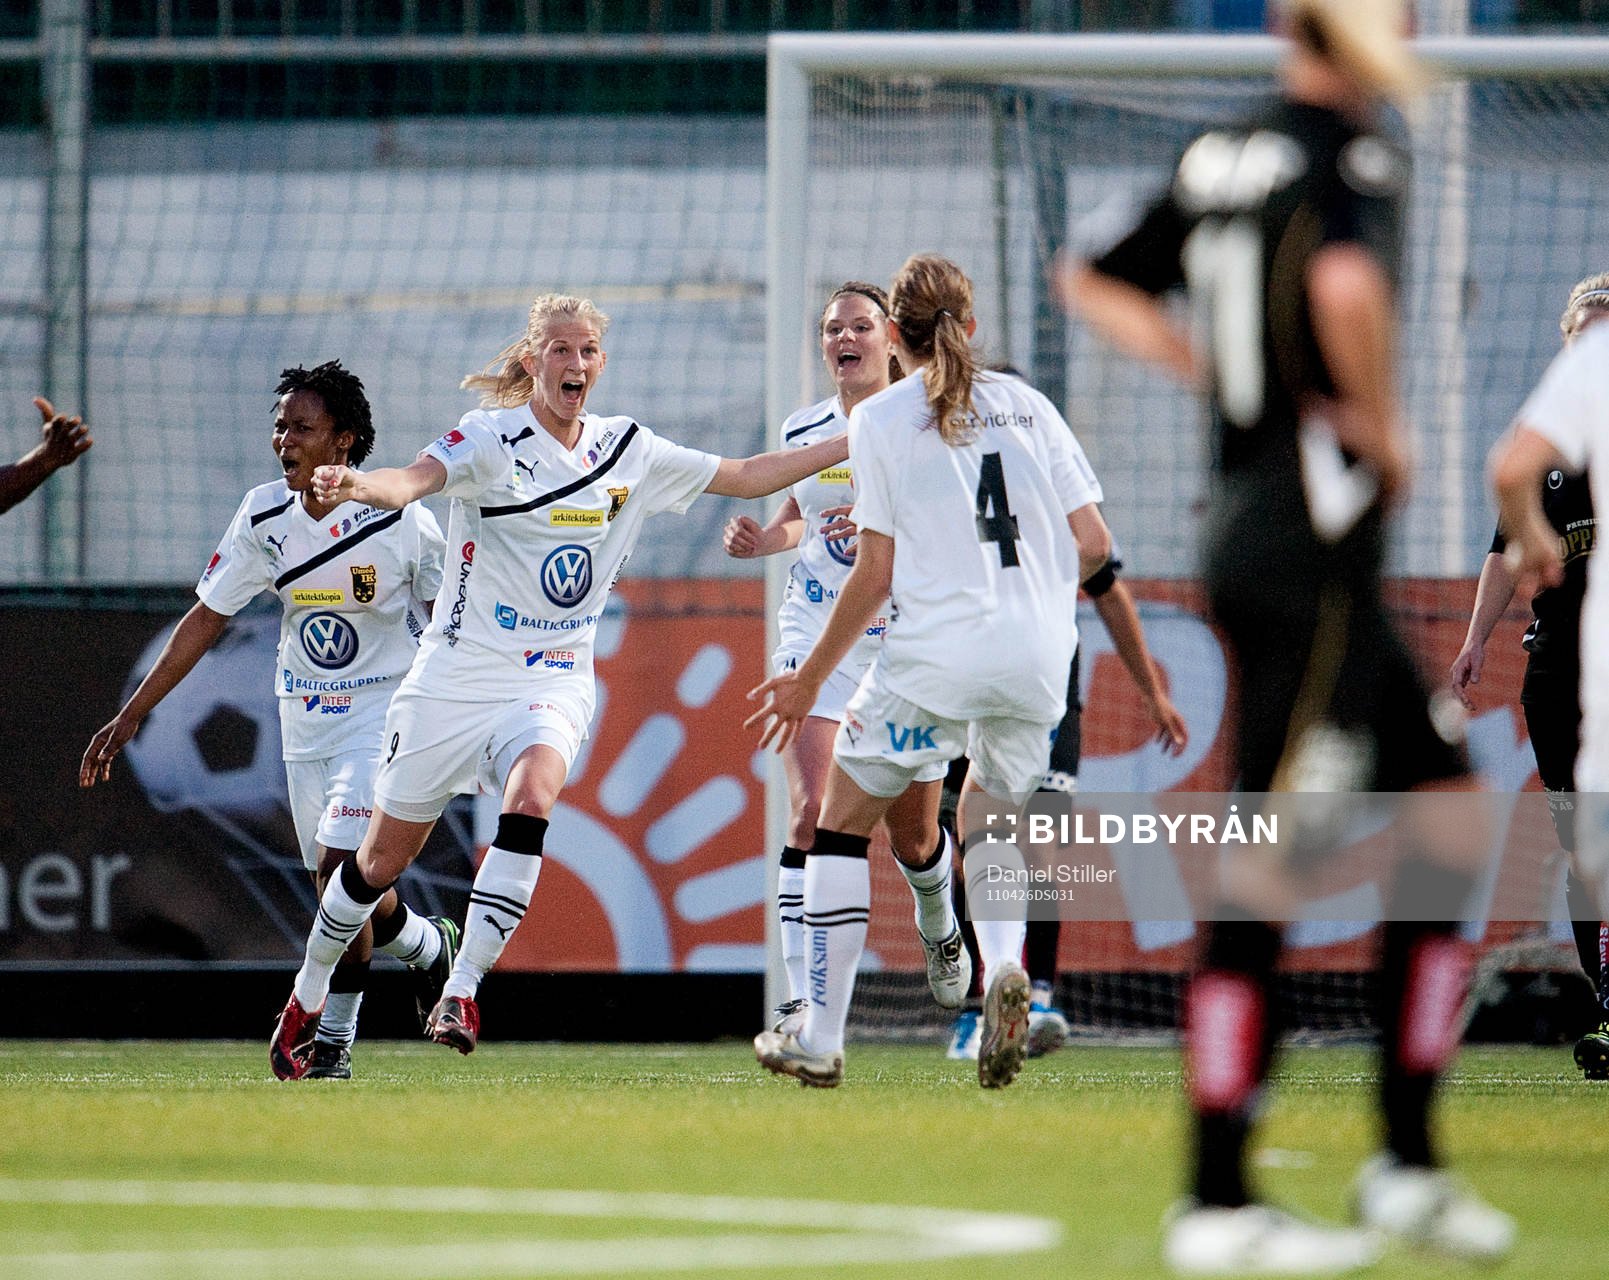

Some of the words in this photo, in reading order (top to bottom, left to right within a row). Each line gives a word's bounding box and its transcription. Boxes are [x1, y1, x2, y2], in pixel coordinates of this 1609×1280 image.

[976, 452, 1020, 568] 4
[552, 513, 601, 524] arkitektkopia
[544, 651, 575, 661] INTER
[544, 660, 575, 670] SPORT
[321, 696, 352, 705] INTER
[321, 705, 351, 714] SPORT
[885, 721, 938, 752] VK
[387, 731, 400, 764] 9
